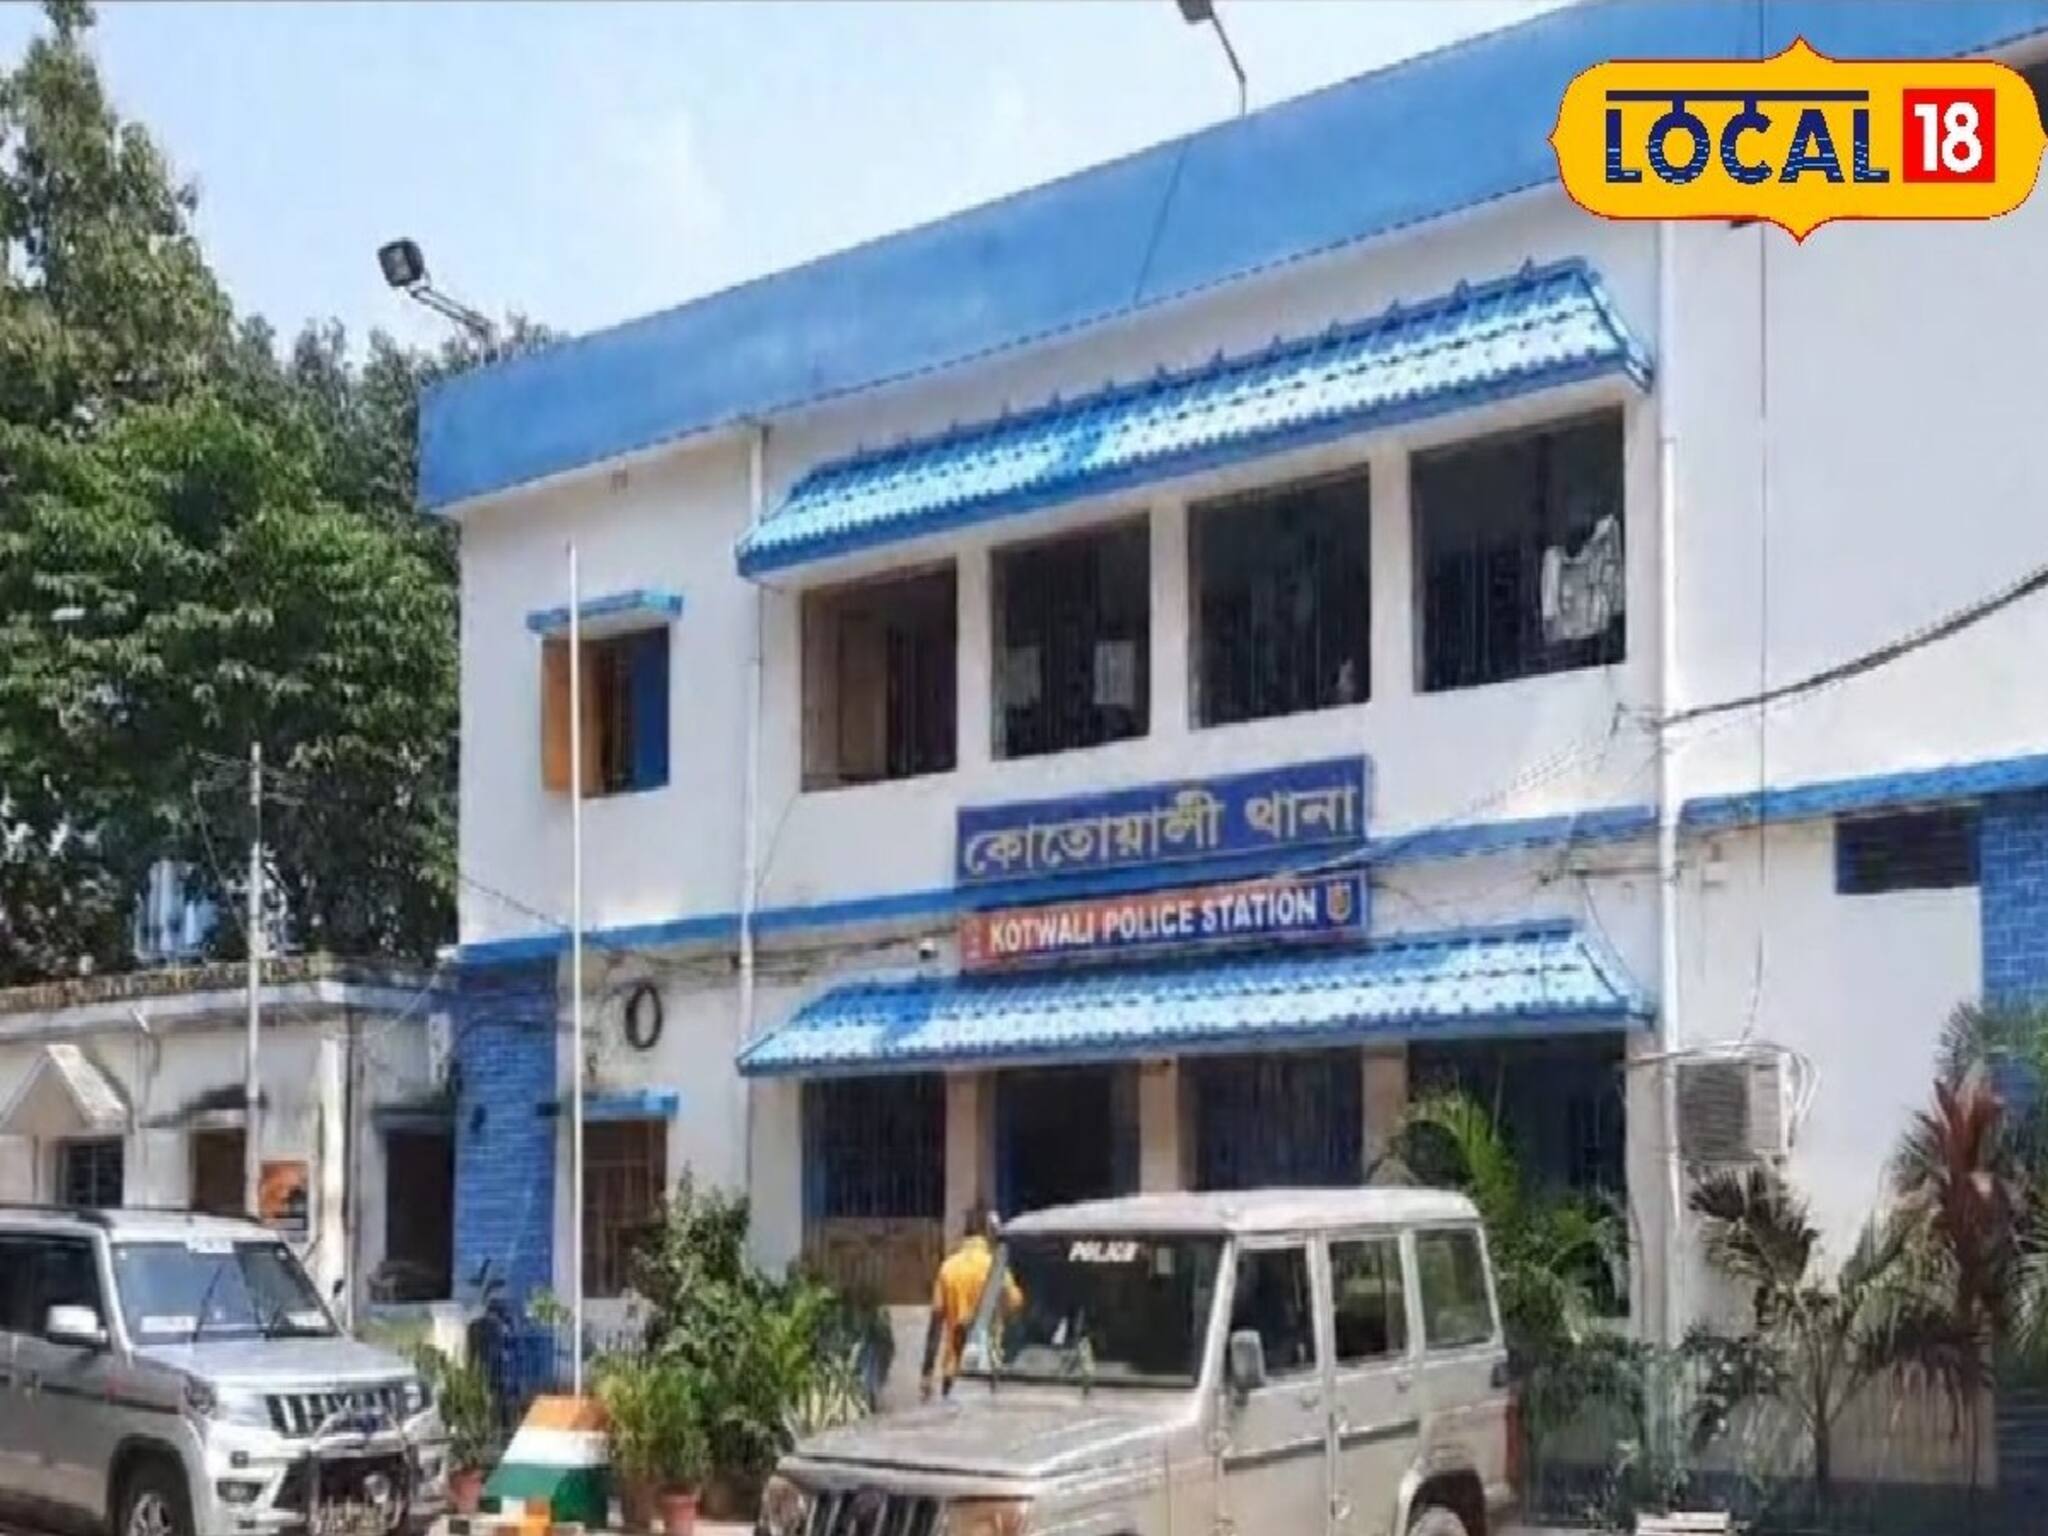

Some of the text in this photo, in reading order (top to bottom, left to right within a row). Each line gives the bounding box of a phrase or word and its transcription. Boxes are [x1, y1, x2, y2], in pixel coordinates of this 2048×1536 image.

[1245, 785, 1359, 842] থানা
[988, 889, 1316, 952] KOTWALI POLICE STATION
